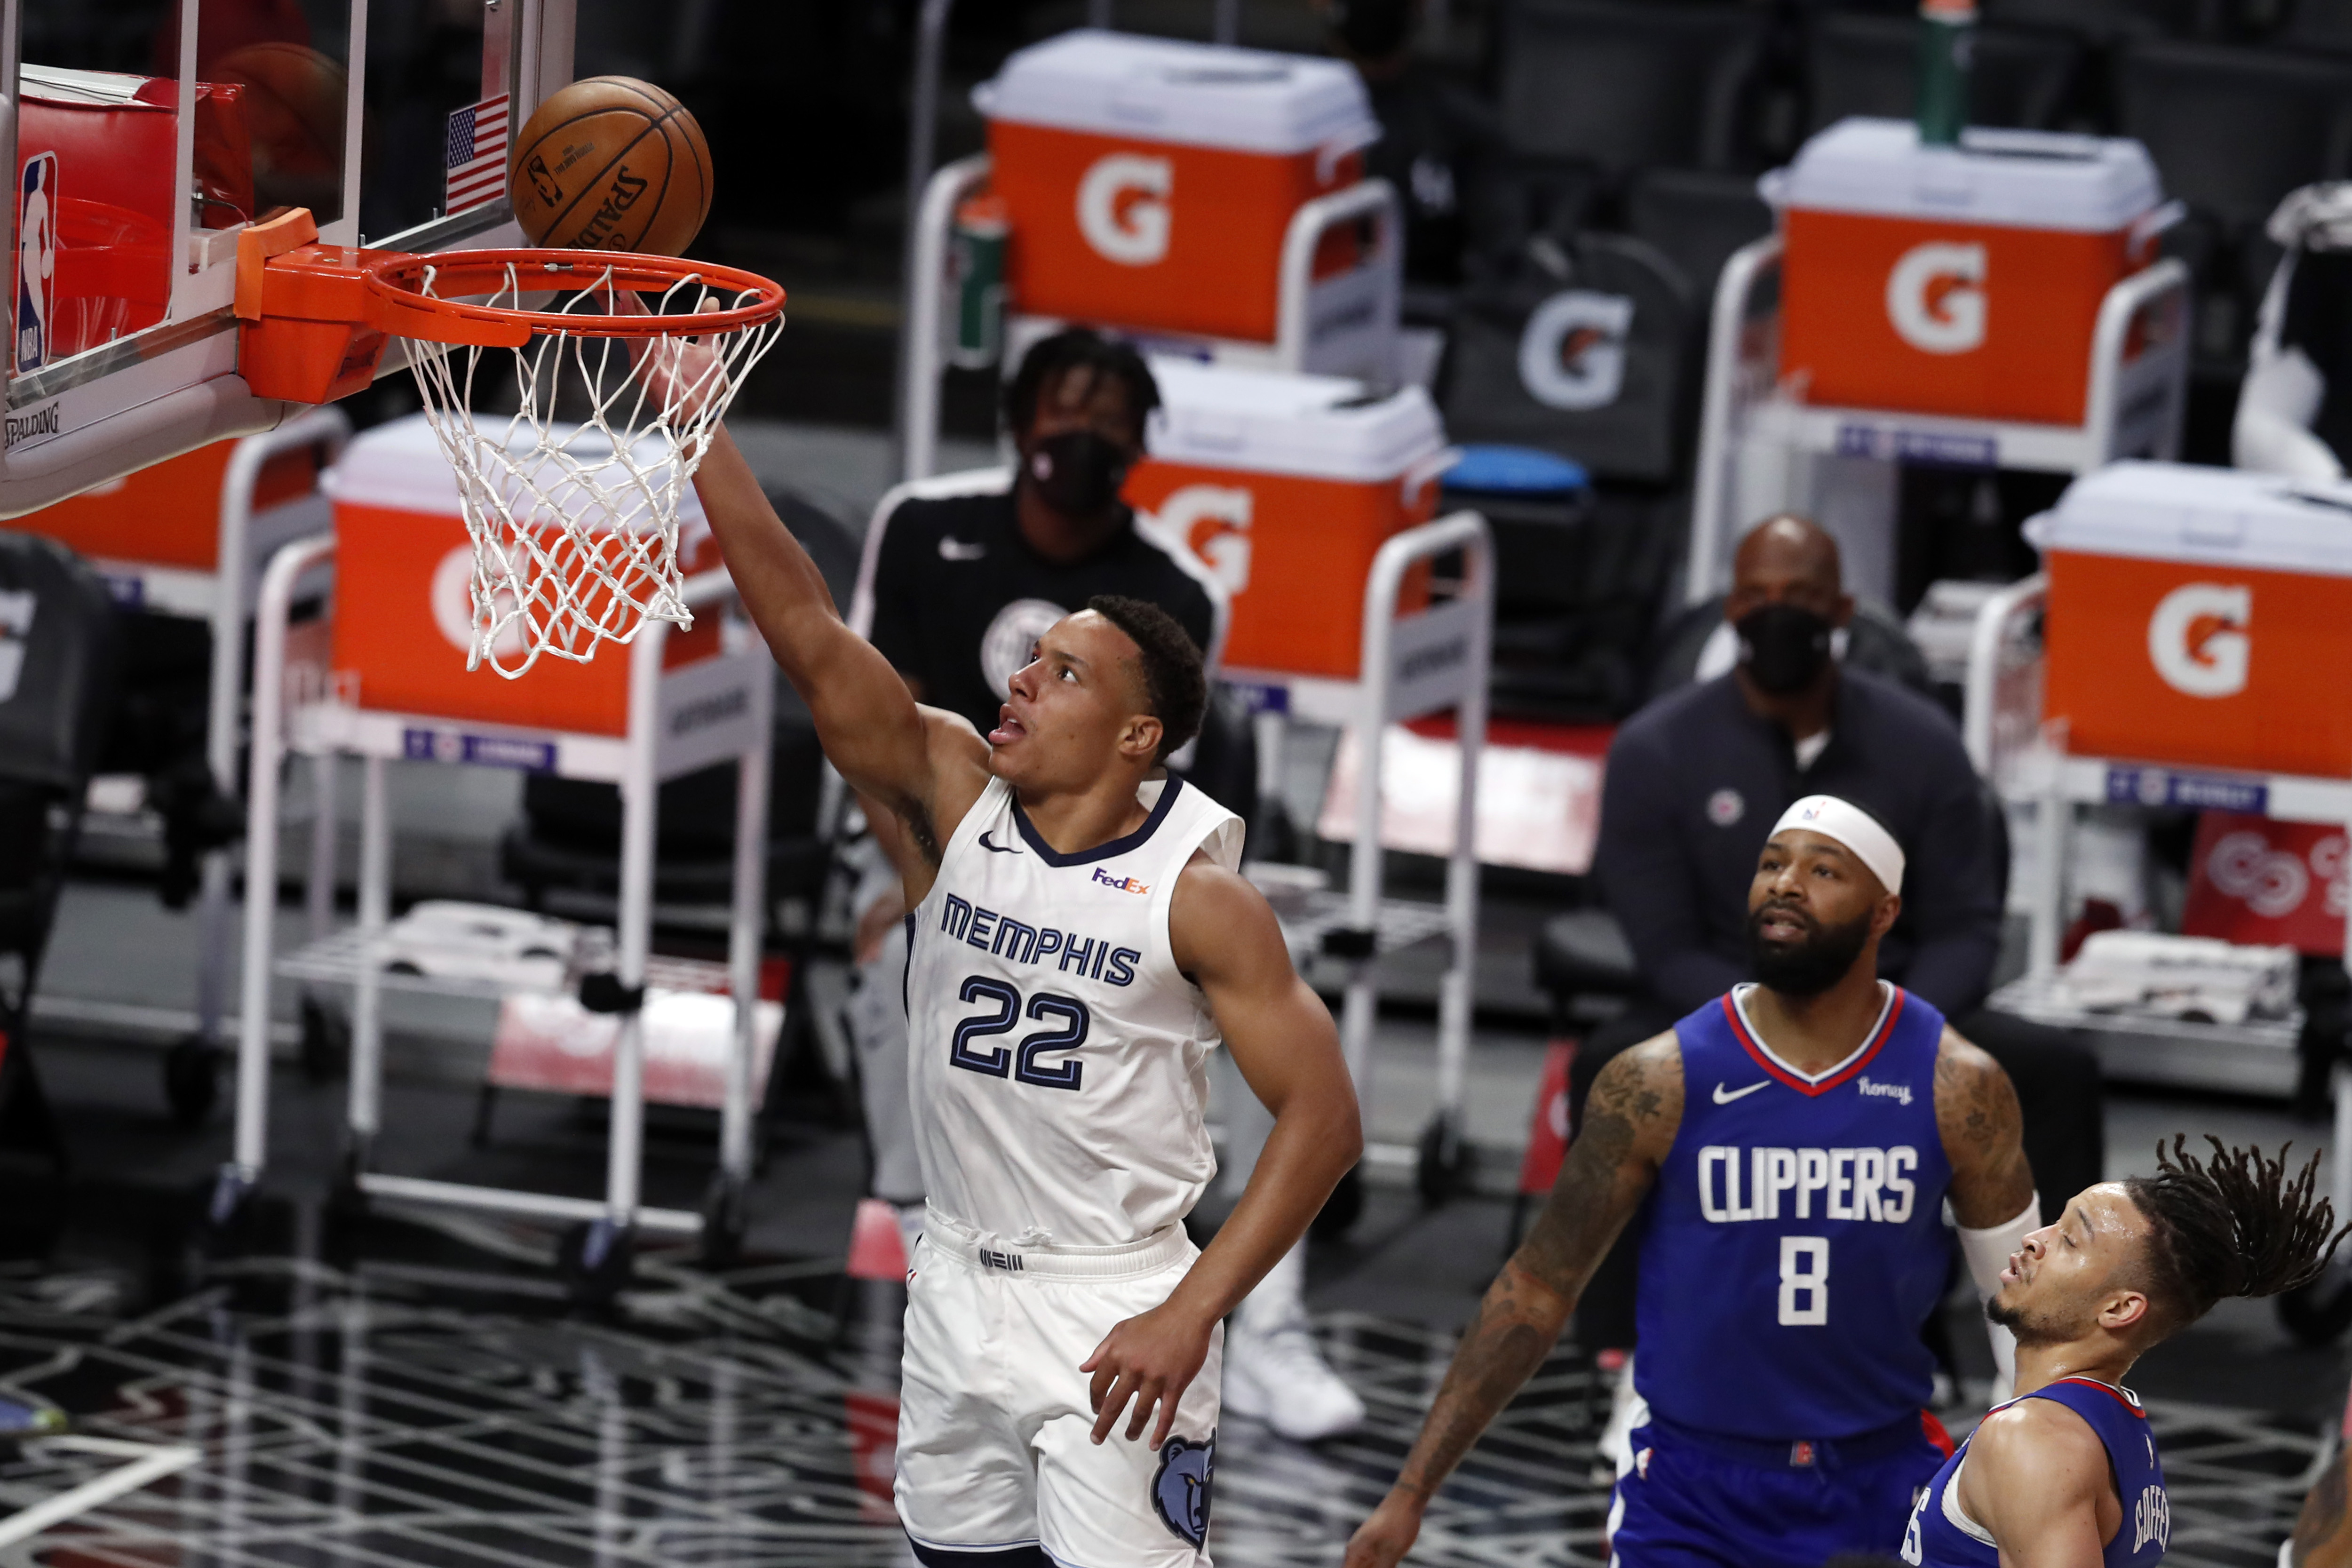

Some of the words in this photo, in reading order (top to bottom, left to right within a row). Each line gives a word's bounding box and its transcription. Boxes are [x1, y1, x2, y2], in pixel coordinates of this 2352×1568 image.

[566, 165, 648, 249] SPALD
[1075, 151, 1174, 267] G
[1885, 240, 1988, 354] G
[21, 325, 39, 363] NBA
[1518, 288, 1635, 408] G
[4, 400, 59, 450] SPALDING
[429, 541, 530, 658] G
[2147, 583, 2252, 697] G
[1091, 867, 1151, 894] FedEx
[941, 892, 1142, 987] MEMPHIS
[949, 975, 1090, 1091] 22
[1857, 1075, 1914, 1106] honey
[1698, 1145, 1918, 1223] CLIPPERS
[1778, 1235, 1829, 1326] 8
